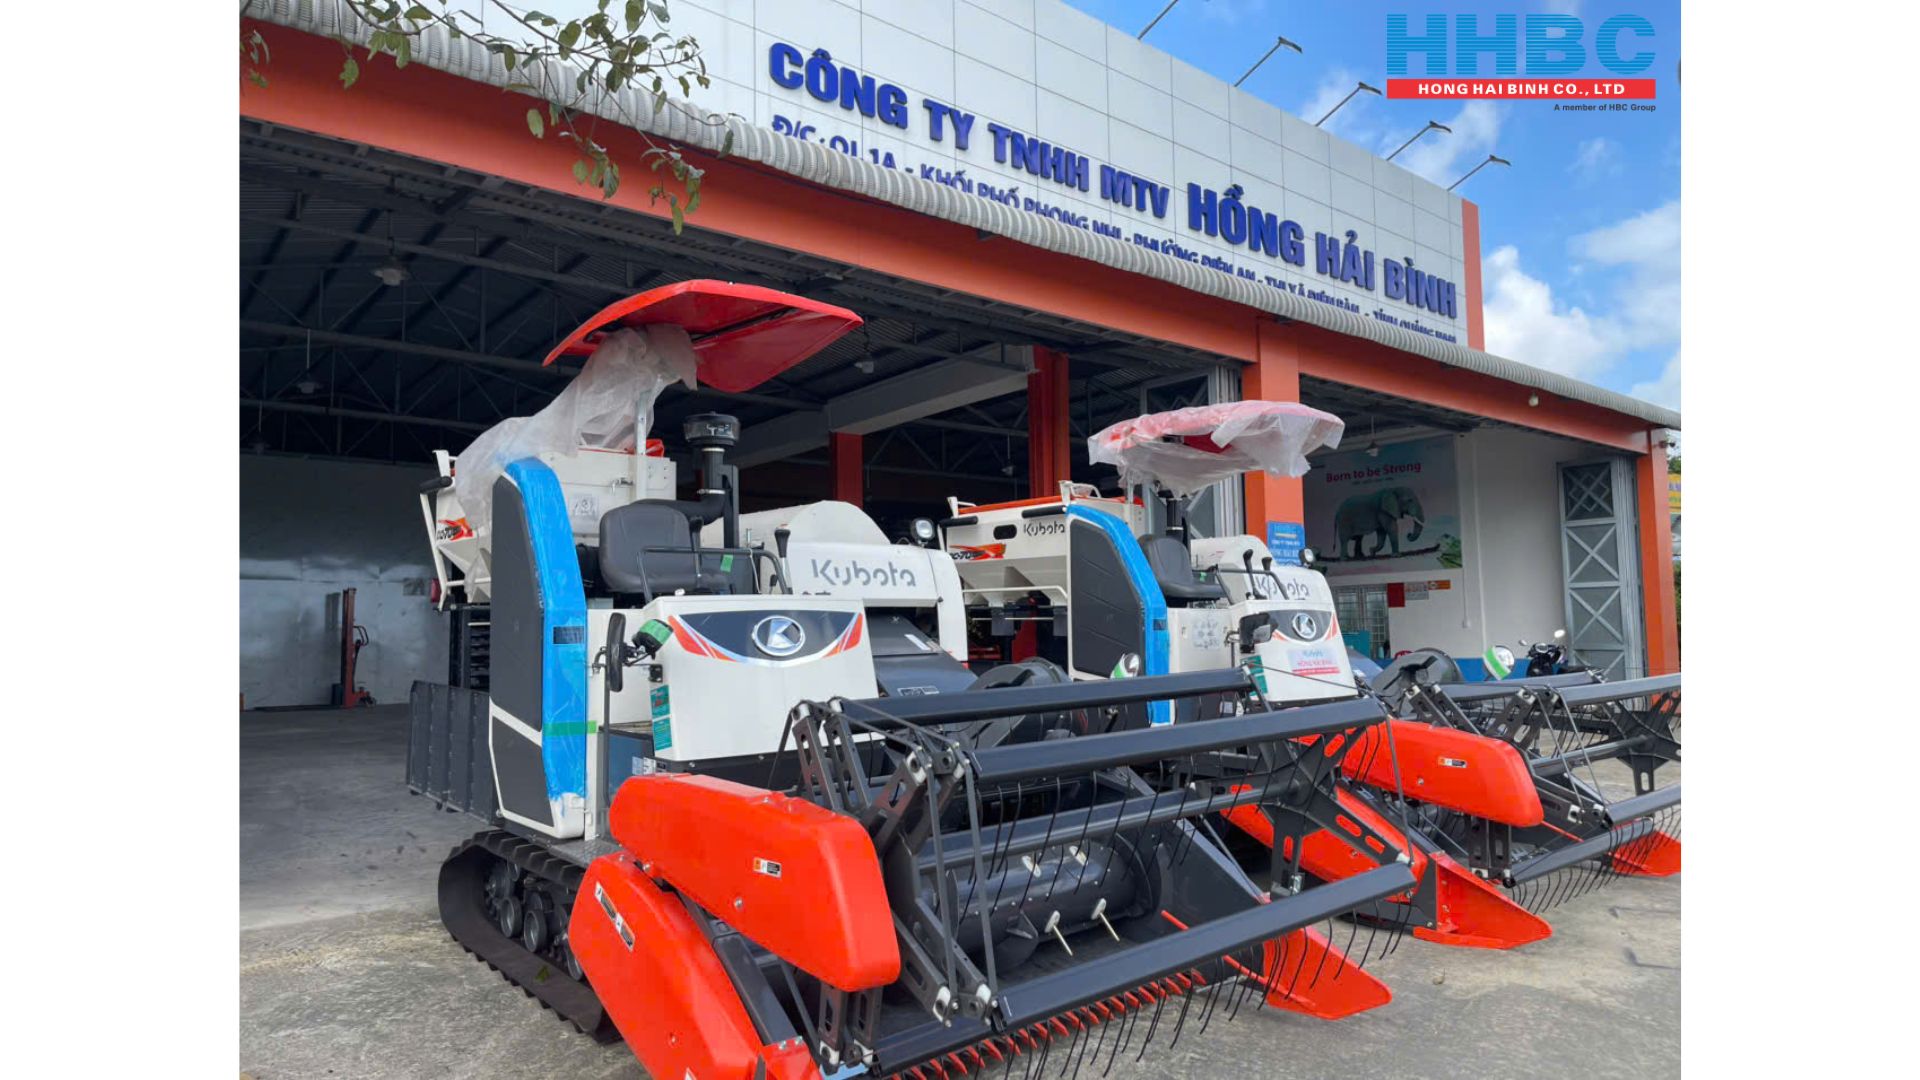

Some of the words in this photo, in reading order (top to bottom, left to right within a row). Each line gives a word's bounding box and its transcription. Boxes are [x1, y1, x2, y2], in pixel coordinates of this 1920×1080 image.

[768, 42, 908, 130] CÔNG
[922, 98, 976, 151] TY
[987, 122, 1090, 192] TNHH
[1099, 163, 1171, 219] MTV
[1186, 181, 1305, 267] HỒNG
[1314, 230, 1376, 291] HẢI
[1383, 256, 1458, 319] BÌNH
[1326, 472, 1351, 483] Born
[1353, 469, 1365, 479] to
[1366, 467, 1380, 478] be
[1383, 462, 1422, 475] Strong
[1023, 520, 1066, 537] Kubota
[810, 558, 916, 587] Kubota
